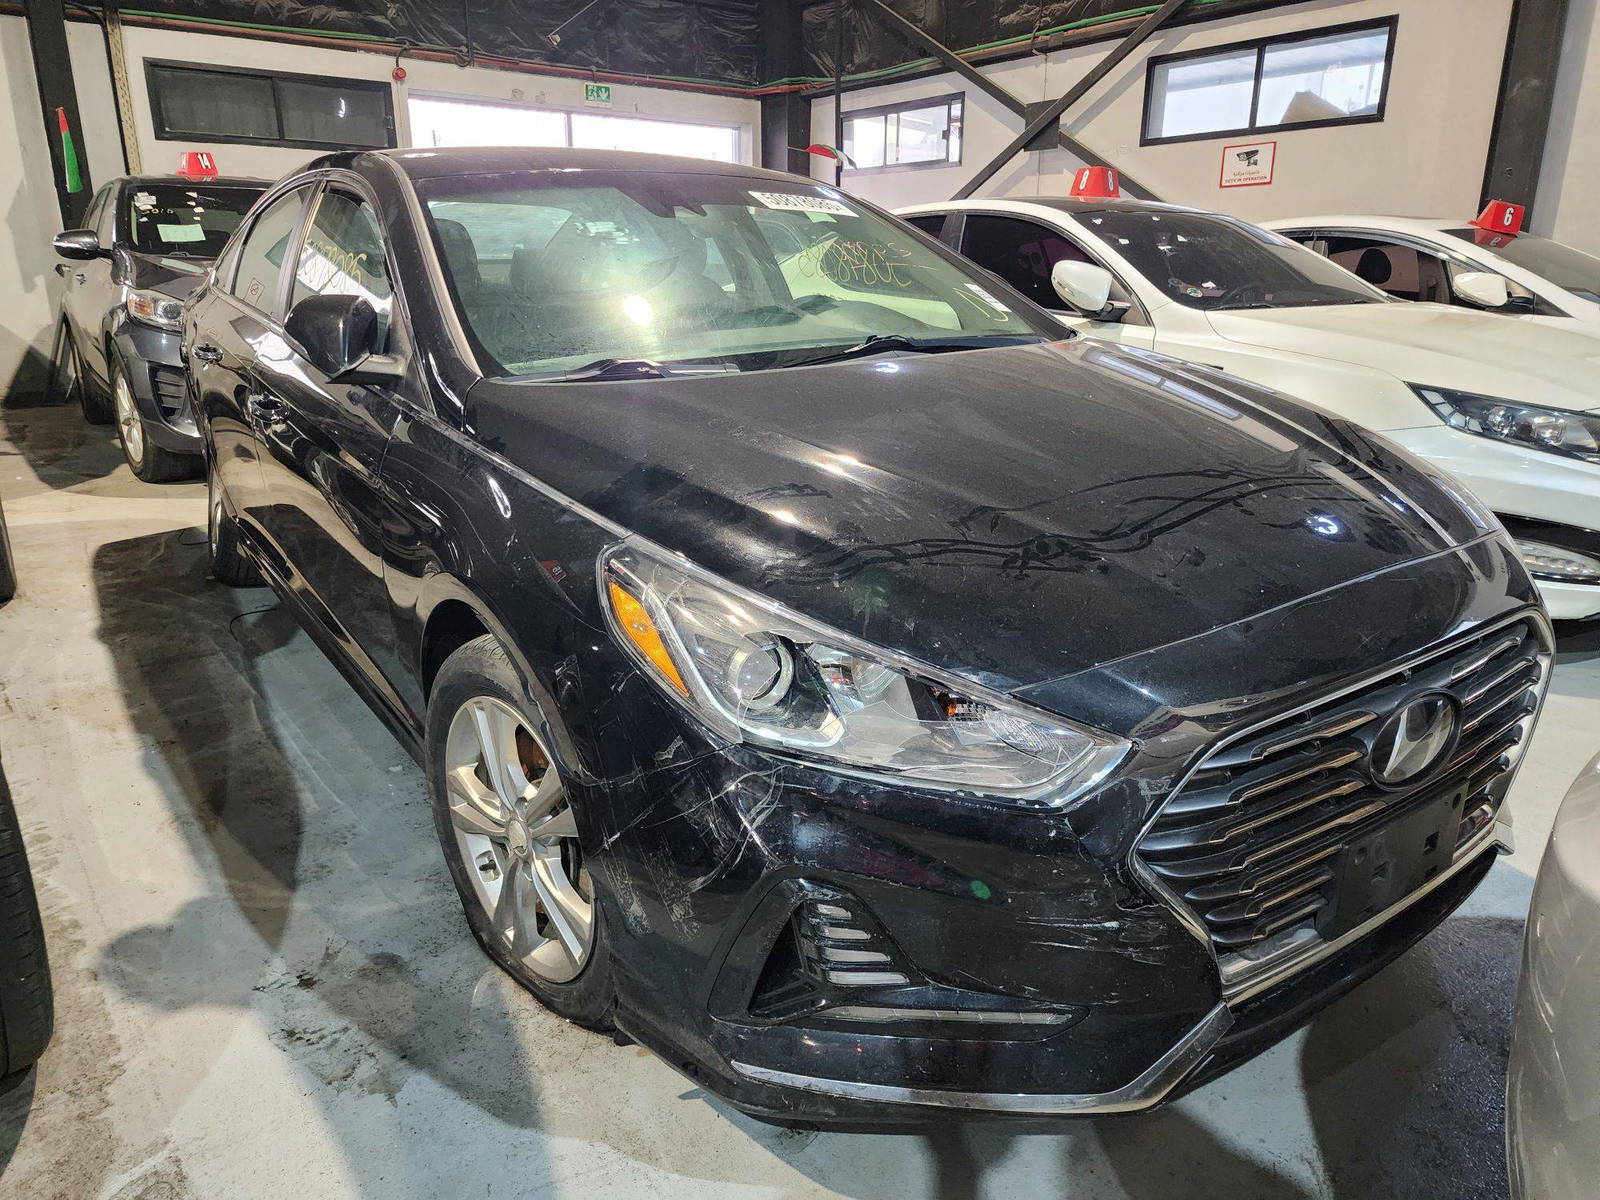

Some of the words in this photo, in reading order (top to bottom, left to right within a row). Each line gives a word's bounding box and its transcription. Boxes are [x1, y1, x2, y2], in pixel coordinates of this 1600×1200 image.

[1078, 169, 1090, 190] 8
[1107, 170, 1114, 191] 8
[1503, 207, 1514, 226] 6
